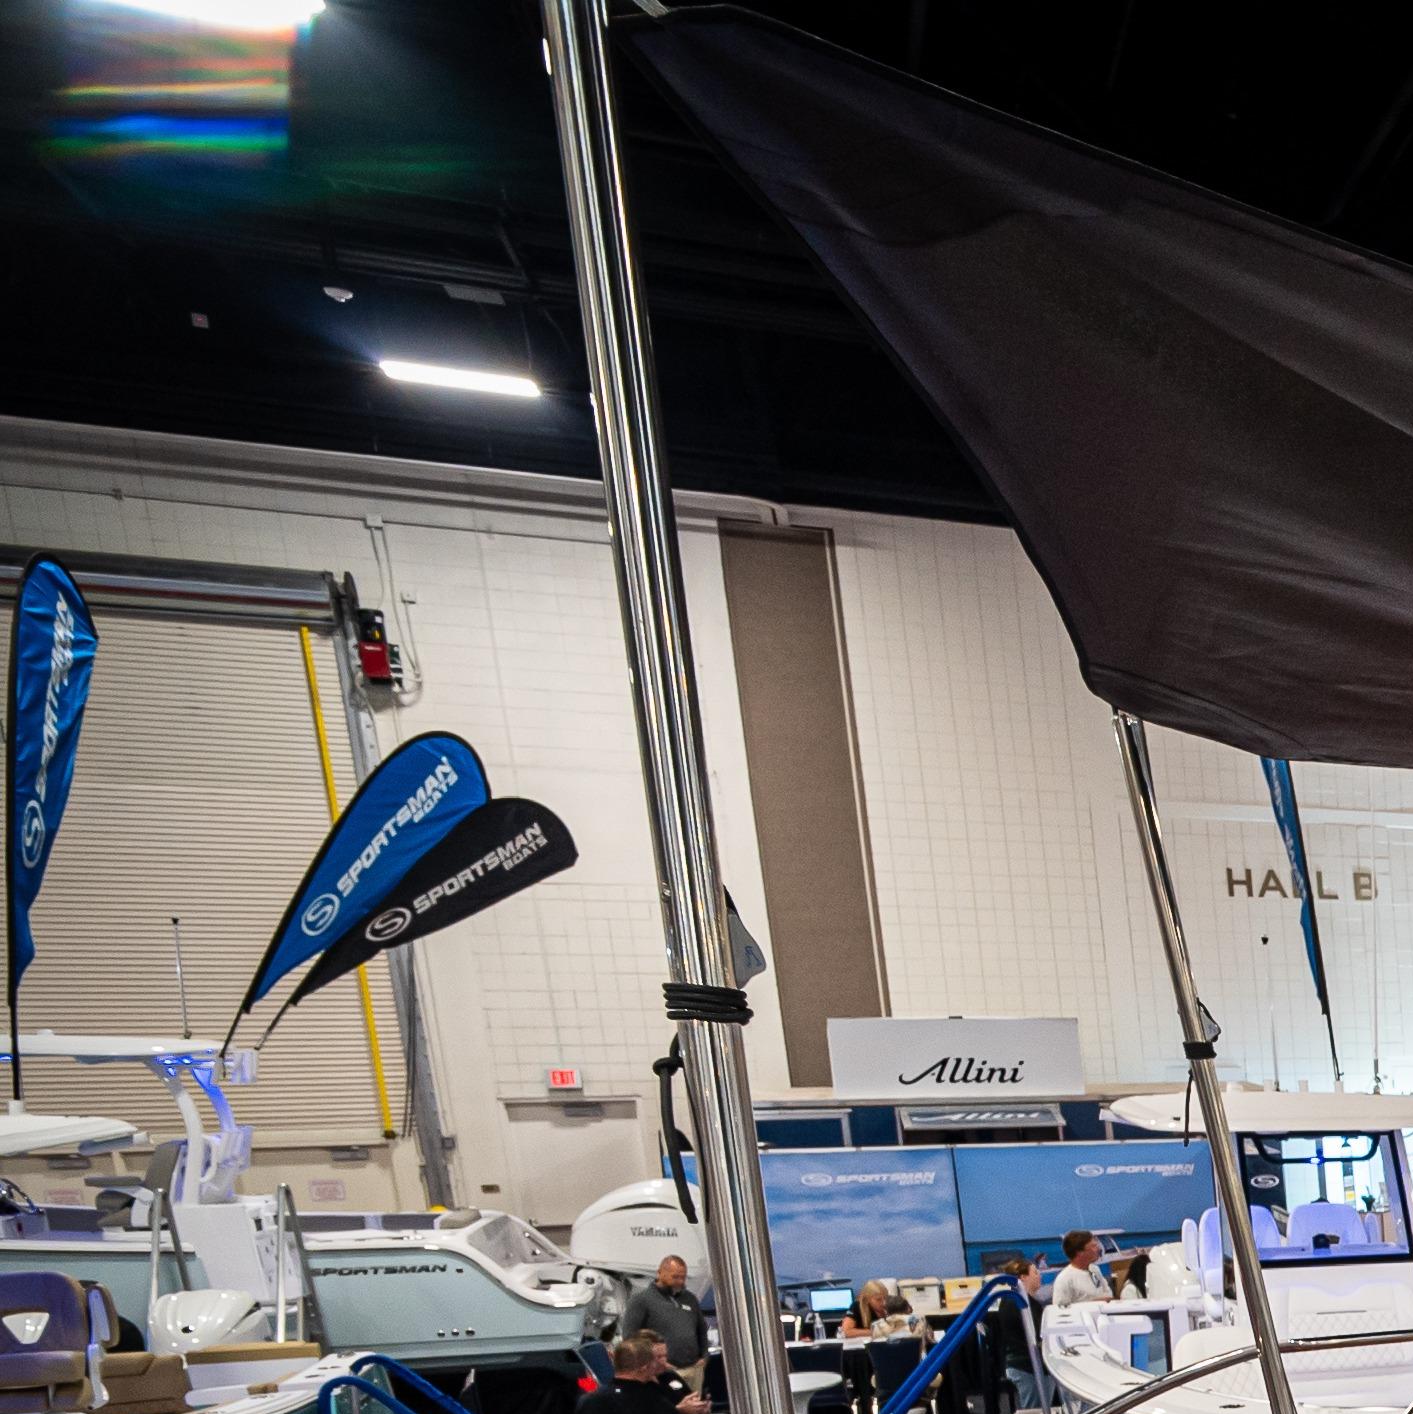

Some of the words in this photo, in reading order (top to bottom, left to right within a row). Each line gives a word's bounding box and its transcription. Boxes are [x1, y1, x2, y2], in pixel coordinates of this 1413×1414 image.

[337, 756, 454, 897] SPORTSMAN
[413, 822, 543, 915] SPORTSMAN
[502, 837, 548, 871] BOATS
[1353, 871, 1378, 900] B
[899, 1057, 1024, 1085] Allini
[310, 1265, 447, 1277] SPORTSMAN
